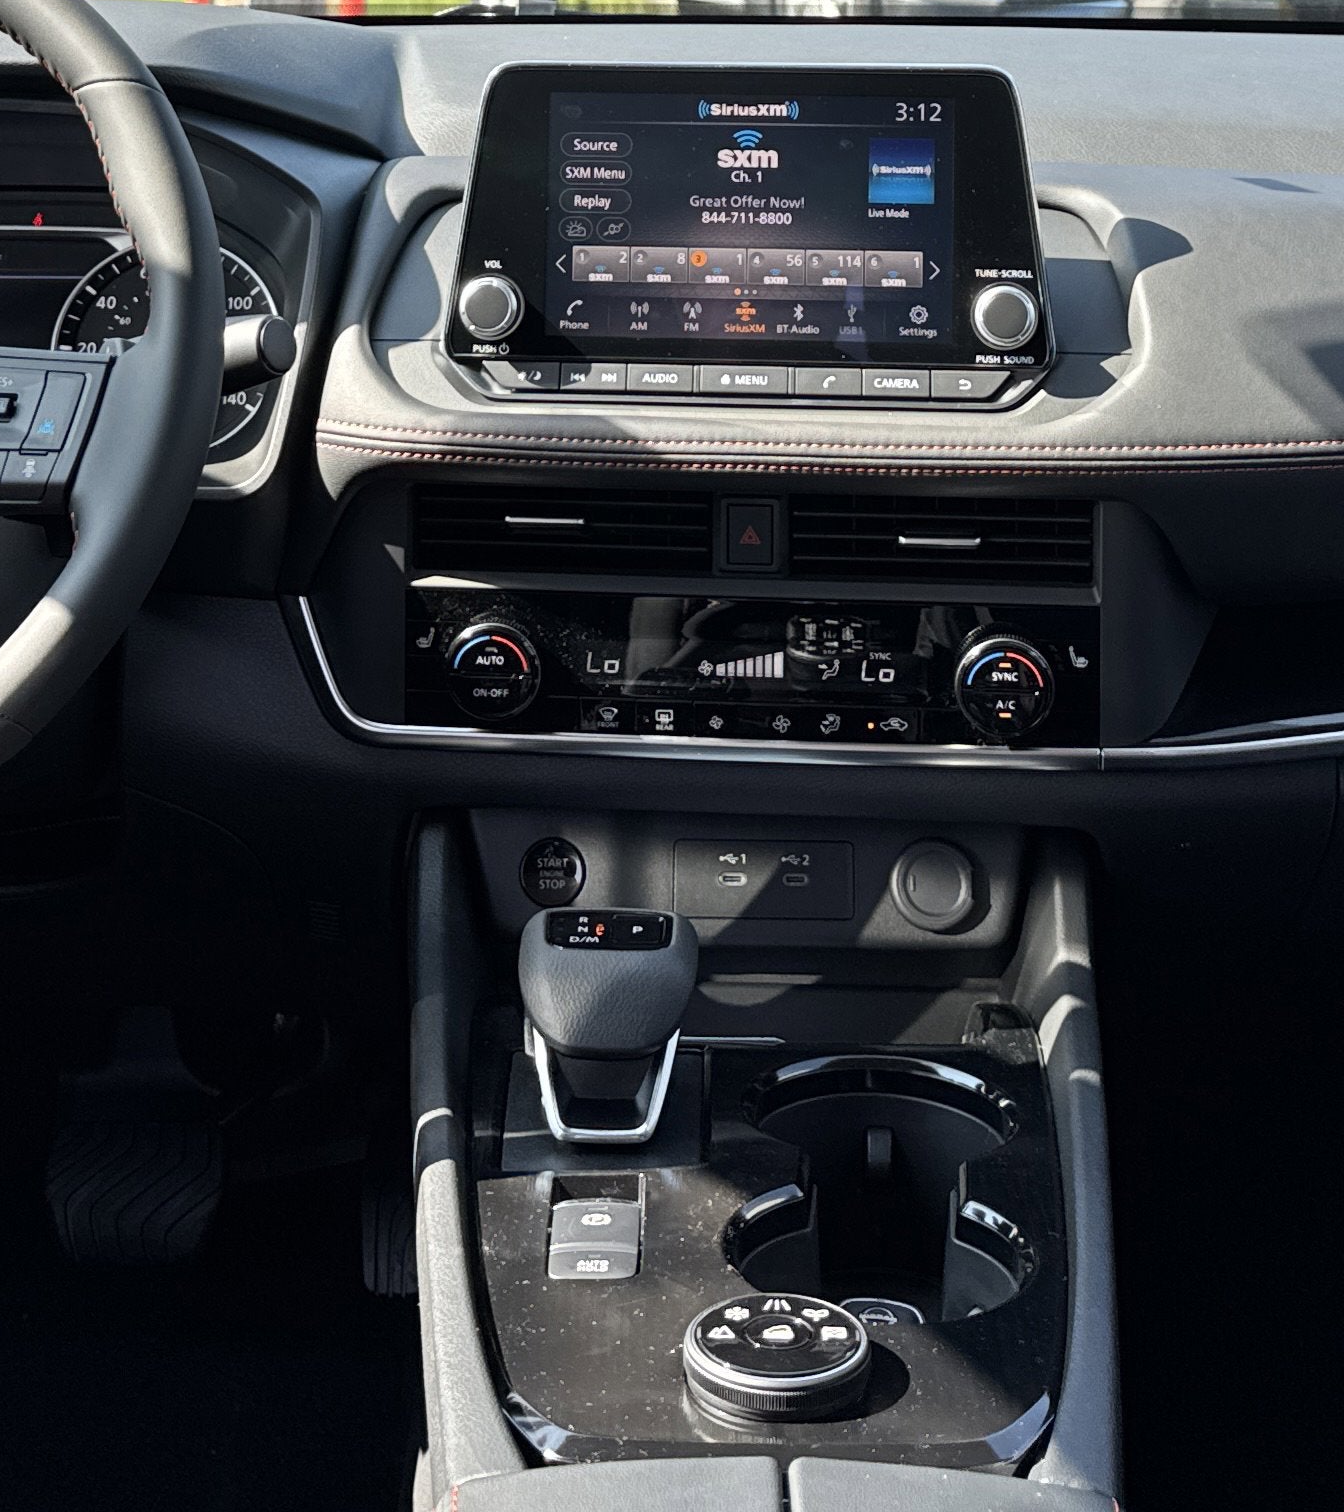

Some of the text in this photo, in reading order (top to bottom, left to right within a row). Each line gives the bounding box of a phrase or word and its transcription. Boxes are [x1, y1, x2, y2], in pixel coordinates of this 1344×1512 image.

[895, 102, 943, 122] 3:12
[573, 138, 619, 151] Source
[565, 167, 626, 180] SXM Menu
[730, 171, 763, 184] Ch. 1
[573, 194, 612, 210] Replay
[689, 195, 805, 210] Great Offer Now!
[701, 211, 793, 225] 844-711-8800
[868, 208, 910, 219] Live Mode
[618, 251, 628, 264] 2
[677, 252, 686, 265] 8
[736, 253, 743, 265] 1
[786, 254, 803, 267] 56
[837, 255, 862, 268] 114
[913, 257, 921, 269] 1
[483, 260, 503, 270] VOL
[95, 296, 118, 310] 40
[227, 296, 254, 311] 100
[118, 316, 132, 326] 60
[559, 319, 590, 330] Phone
[629, 321, 648, 331] AM
[683, 322, 700, 332] FM
[723, 323, 766, 334] SiriusXM
[776, 324, 820, 335] BT Audio
[898, 326, 938, 339] Settings
[77, 342, 97, 354] 20
[472, 344, 498, 354] PUSH
[975, 354, 1035, 365] PUSH SOUND
[642, 372, 679, 384] AUDIO
[734, 374, 769, 386] MENU
[873, 377, 920, 389] CAMERA
[475, 655, 505, 666] AUTO
[869, 651, 892, 661] SYNC
[586, 651, 621, 674] Lo
[861, 660, 895, 682] Lo
[991, 671, 1019, 683] SYNC
[995, 700, 1017, 710] A/C
[537, 857, 569, 868] START
[740, 853, 747, 865] 1
[802, 854, 810, 866] 2
[539, 879, 566, 890] STOP
[577, 925, 589, 933] N
[632, 925, 644, 934] P
